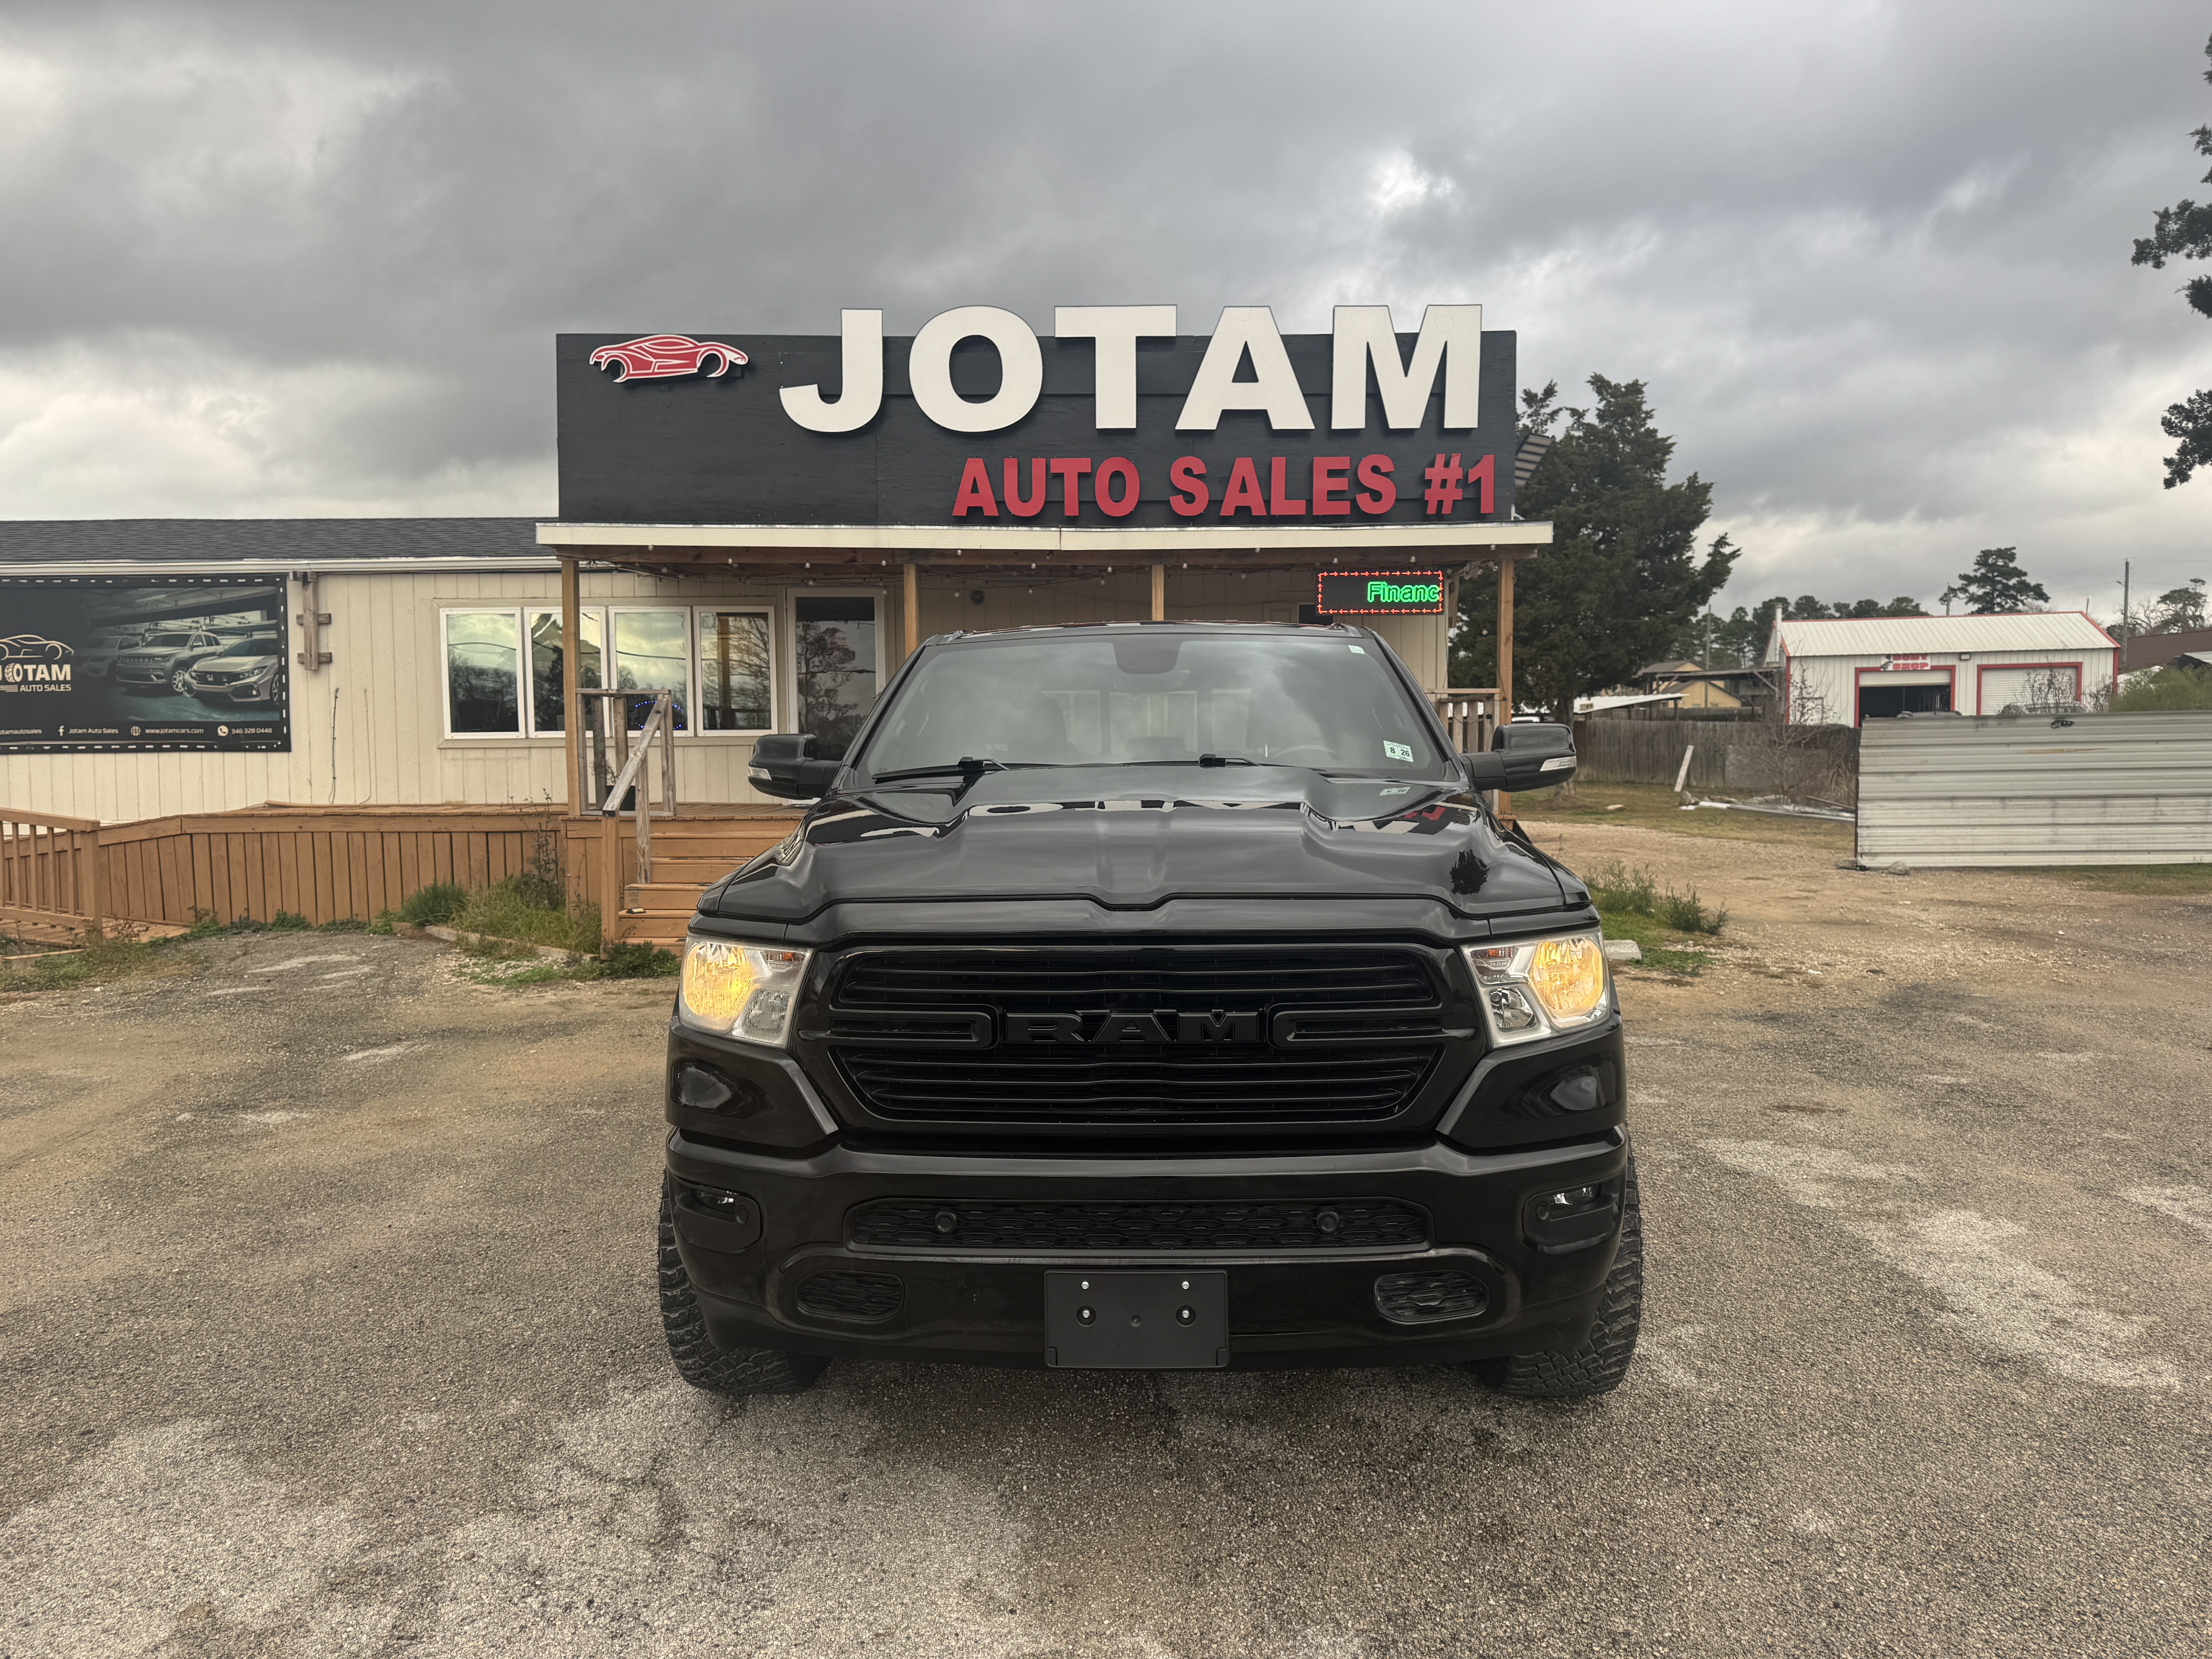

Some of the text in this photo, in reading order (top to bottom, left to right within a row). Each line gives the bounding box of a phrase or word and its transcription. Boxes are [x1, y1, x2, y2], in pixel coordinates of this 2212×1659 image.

[779, 305, 1482, 433] JOTAM
[953, 453, 1495, 517] AUTO SALES #1
[1367, 581, 1440, 603] Financ
[0, 663, 71, 682] OTAM
[1006, 1011, 1258, 1043] RAM
